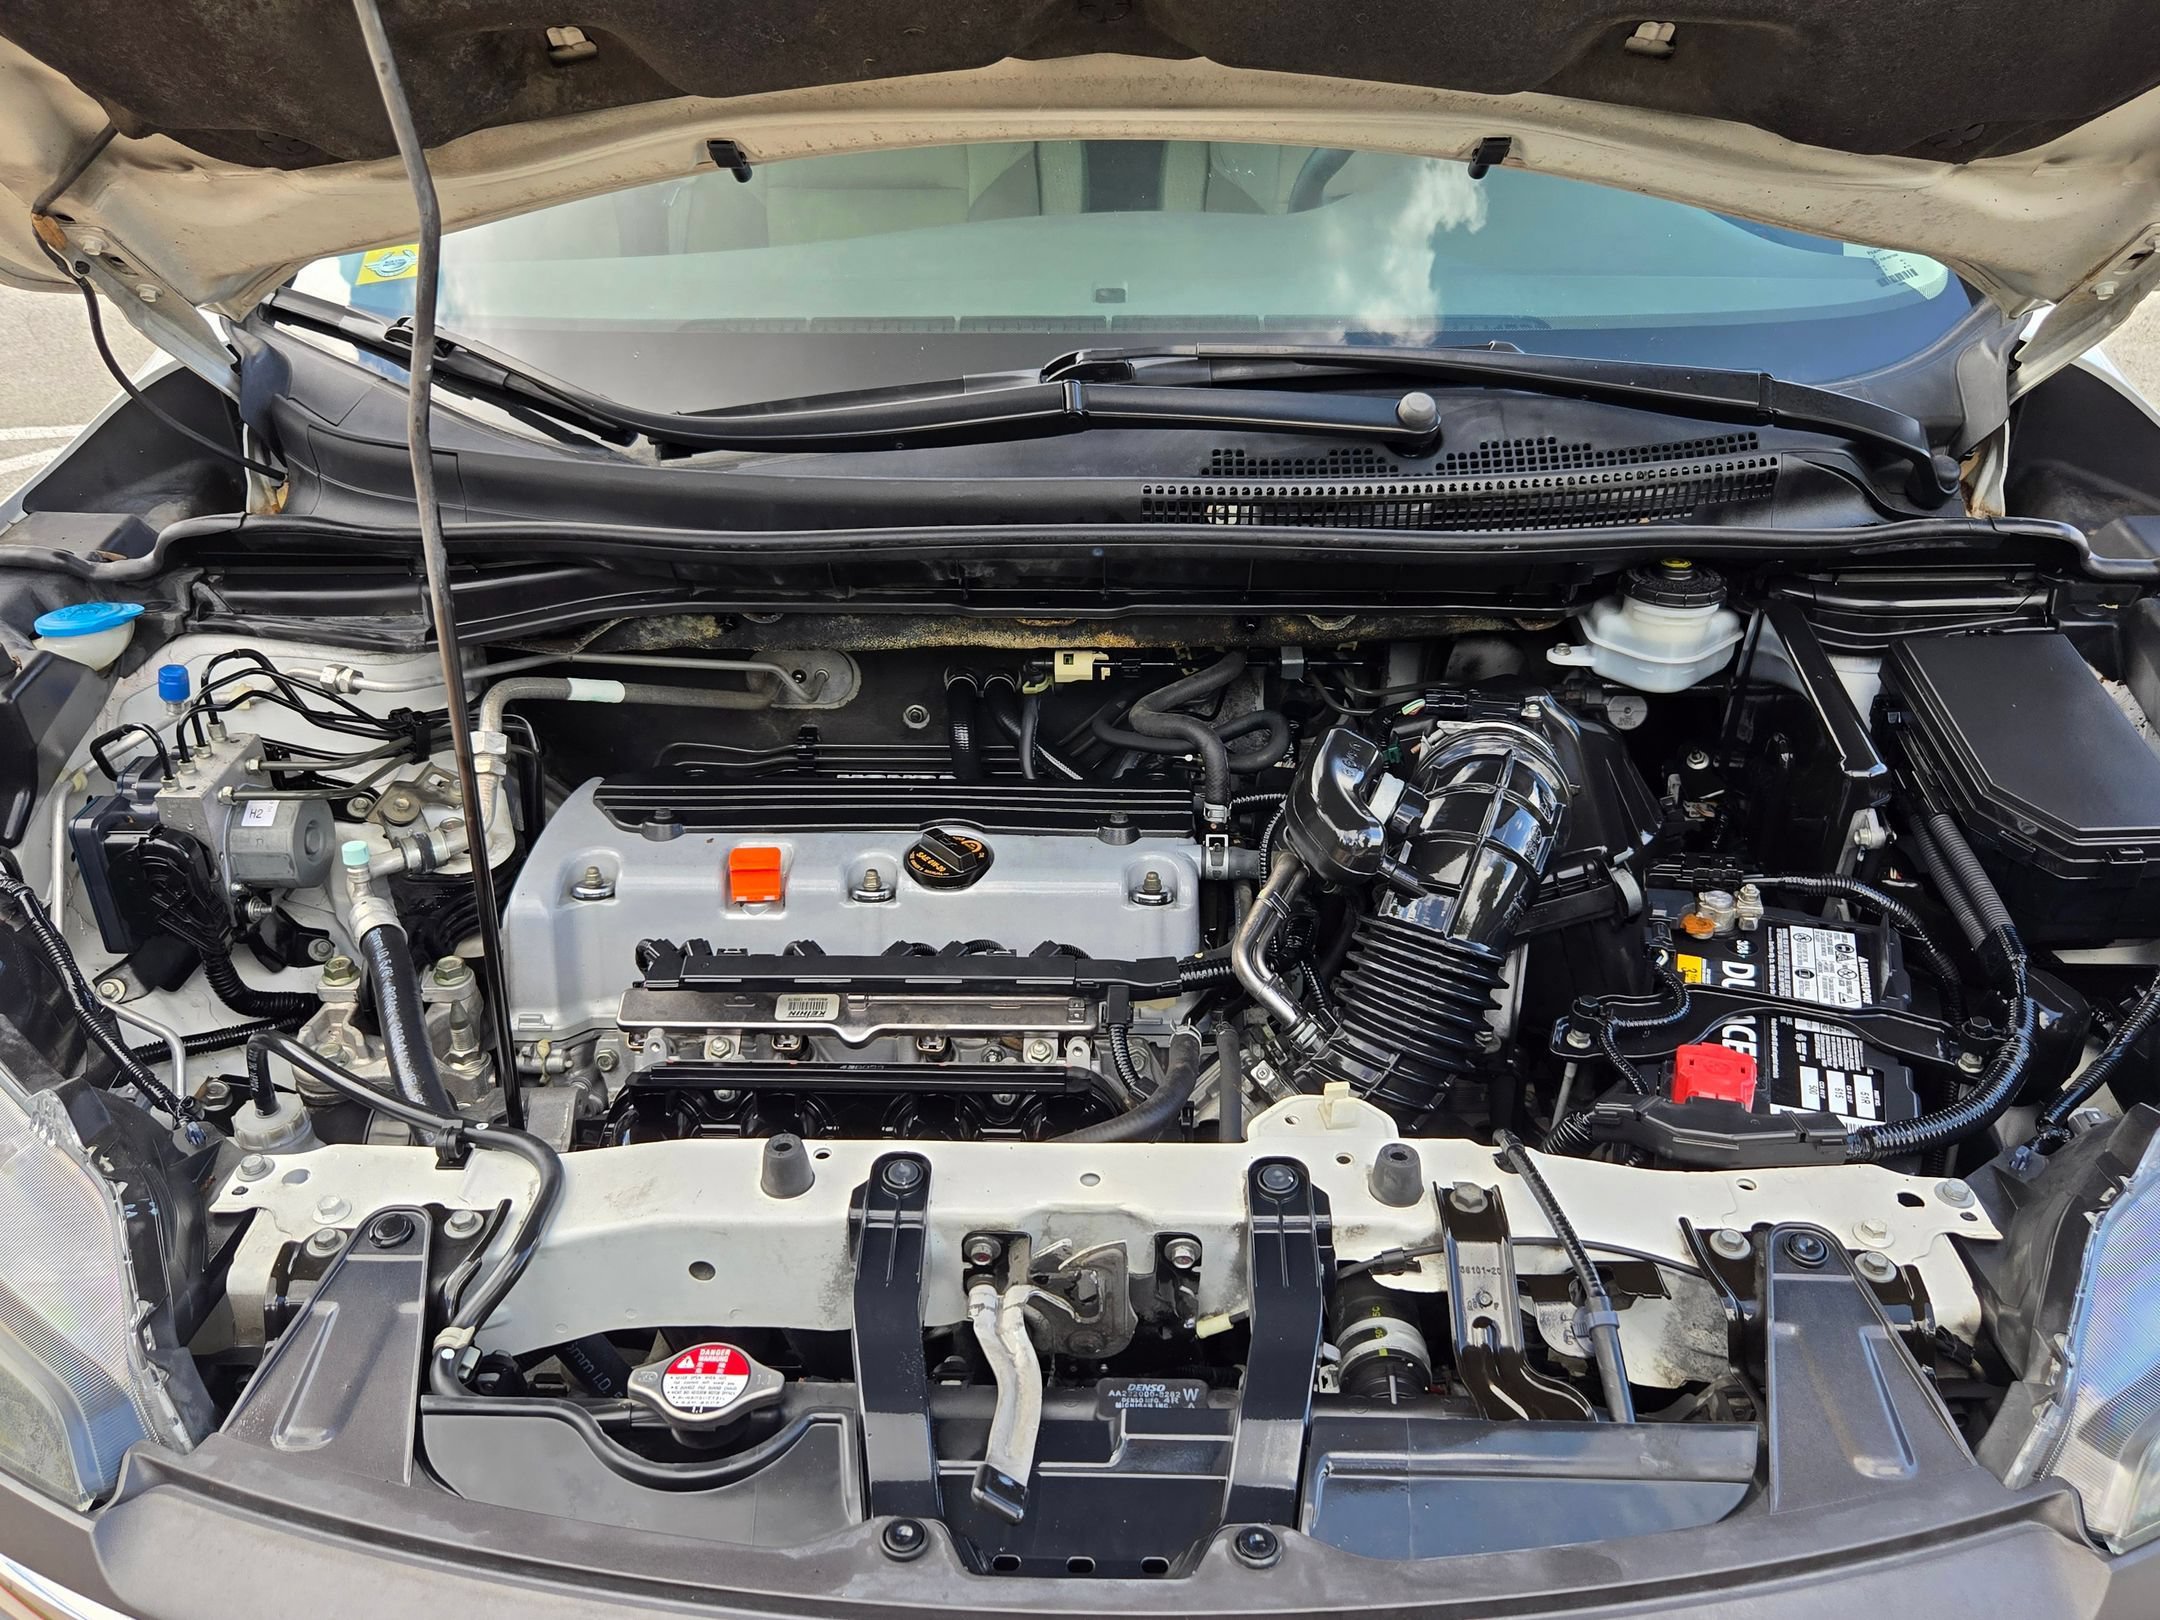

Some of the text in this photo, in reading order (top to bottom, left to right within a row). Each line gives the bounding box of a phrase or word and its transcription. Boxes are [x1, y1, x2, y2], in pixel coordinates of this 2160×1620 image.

[249, 808, 264, 819] H2
[1860, 1091, 1871, 1105] 51R
[700, 1348, 731, 1356] DANGER
[698, 1355, 729, 1363] WARNING
[1127, 1384, 1166, 1392] DENSO
[1182, 1388, 1200, 1401] W
